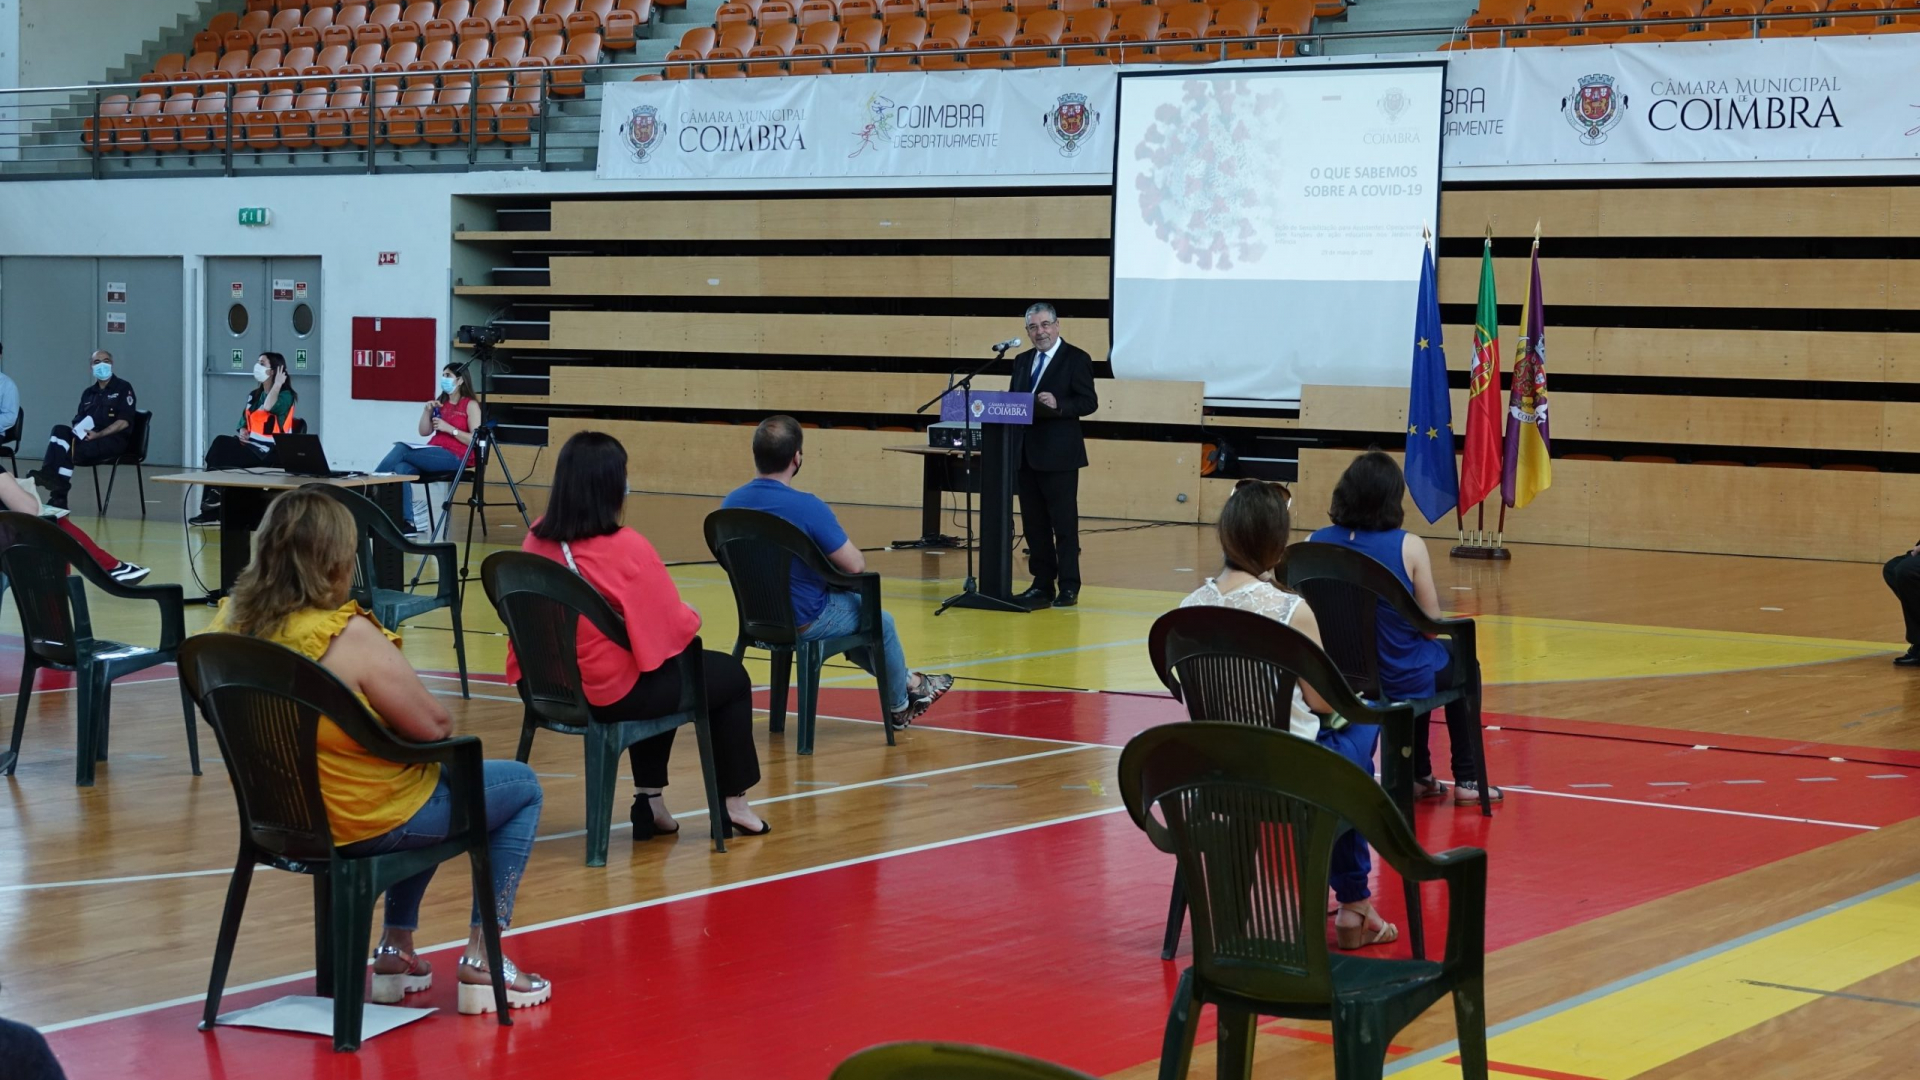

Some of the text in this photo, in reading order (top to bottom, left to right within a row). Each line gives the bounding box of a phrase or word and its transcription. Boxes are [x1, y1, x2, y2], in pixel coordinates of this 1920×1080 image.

[1651, 76, 1842, 96] CÂMARA MUNICIPAL
[680, 108, 807, 124] CÂMARA MUNICIPAL
[897, 103, 984, 129] COIMBRA
[1648, 95, 1844, 131] COIMBRA
[679, 124, 807, 153] COIMBRA
[893, 133, 999, 149] DESPORTIVAMENTE
[1363, 132, 1421, 145] COIMBRA
[1310, 165, 1418, 181] O QUE SABEMOS
[1304, 183, 1423, 198] SOBRE A COVID-19
[988, 406, 1027, 416] COIMBRA
